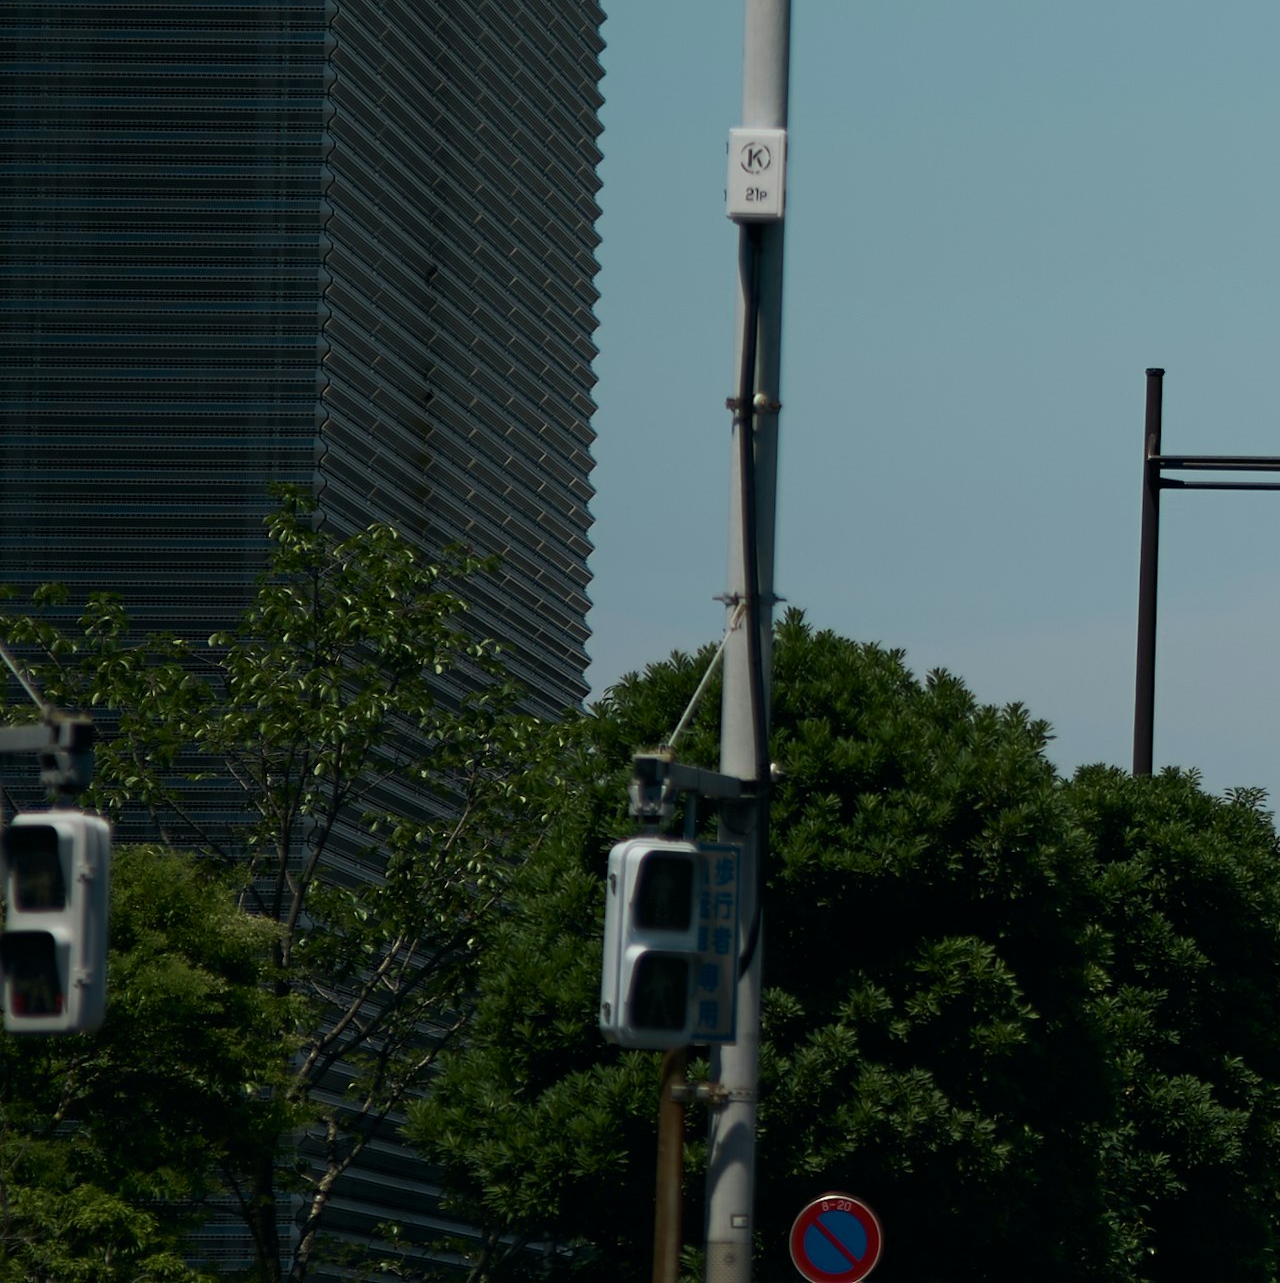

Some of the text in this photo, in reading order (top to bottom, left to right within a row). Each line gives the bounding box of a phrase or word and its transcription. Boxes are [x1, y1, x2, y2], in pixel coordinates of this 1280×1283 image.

[747, 148, 763, 168] K
[713, 858, 735, 955] 歩行者
[821, 1200, 852, 1212] 8-20
